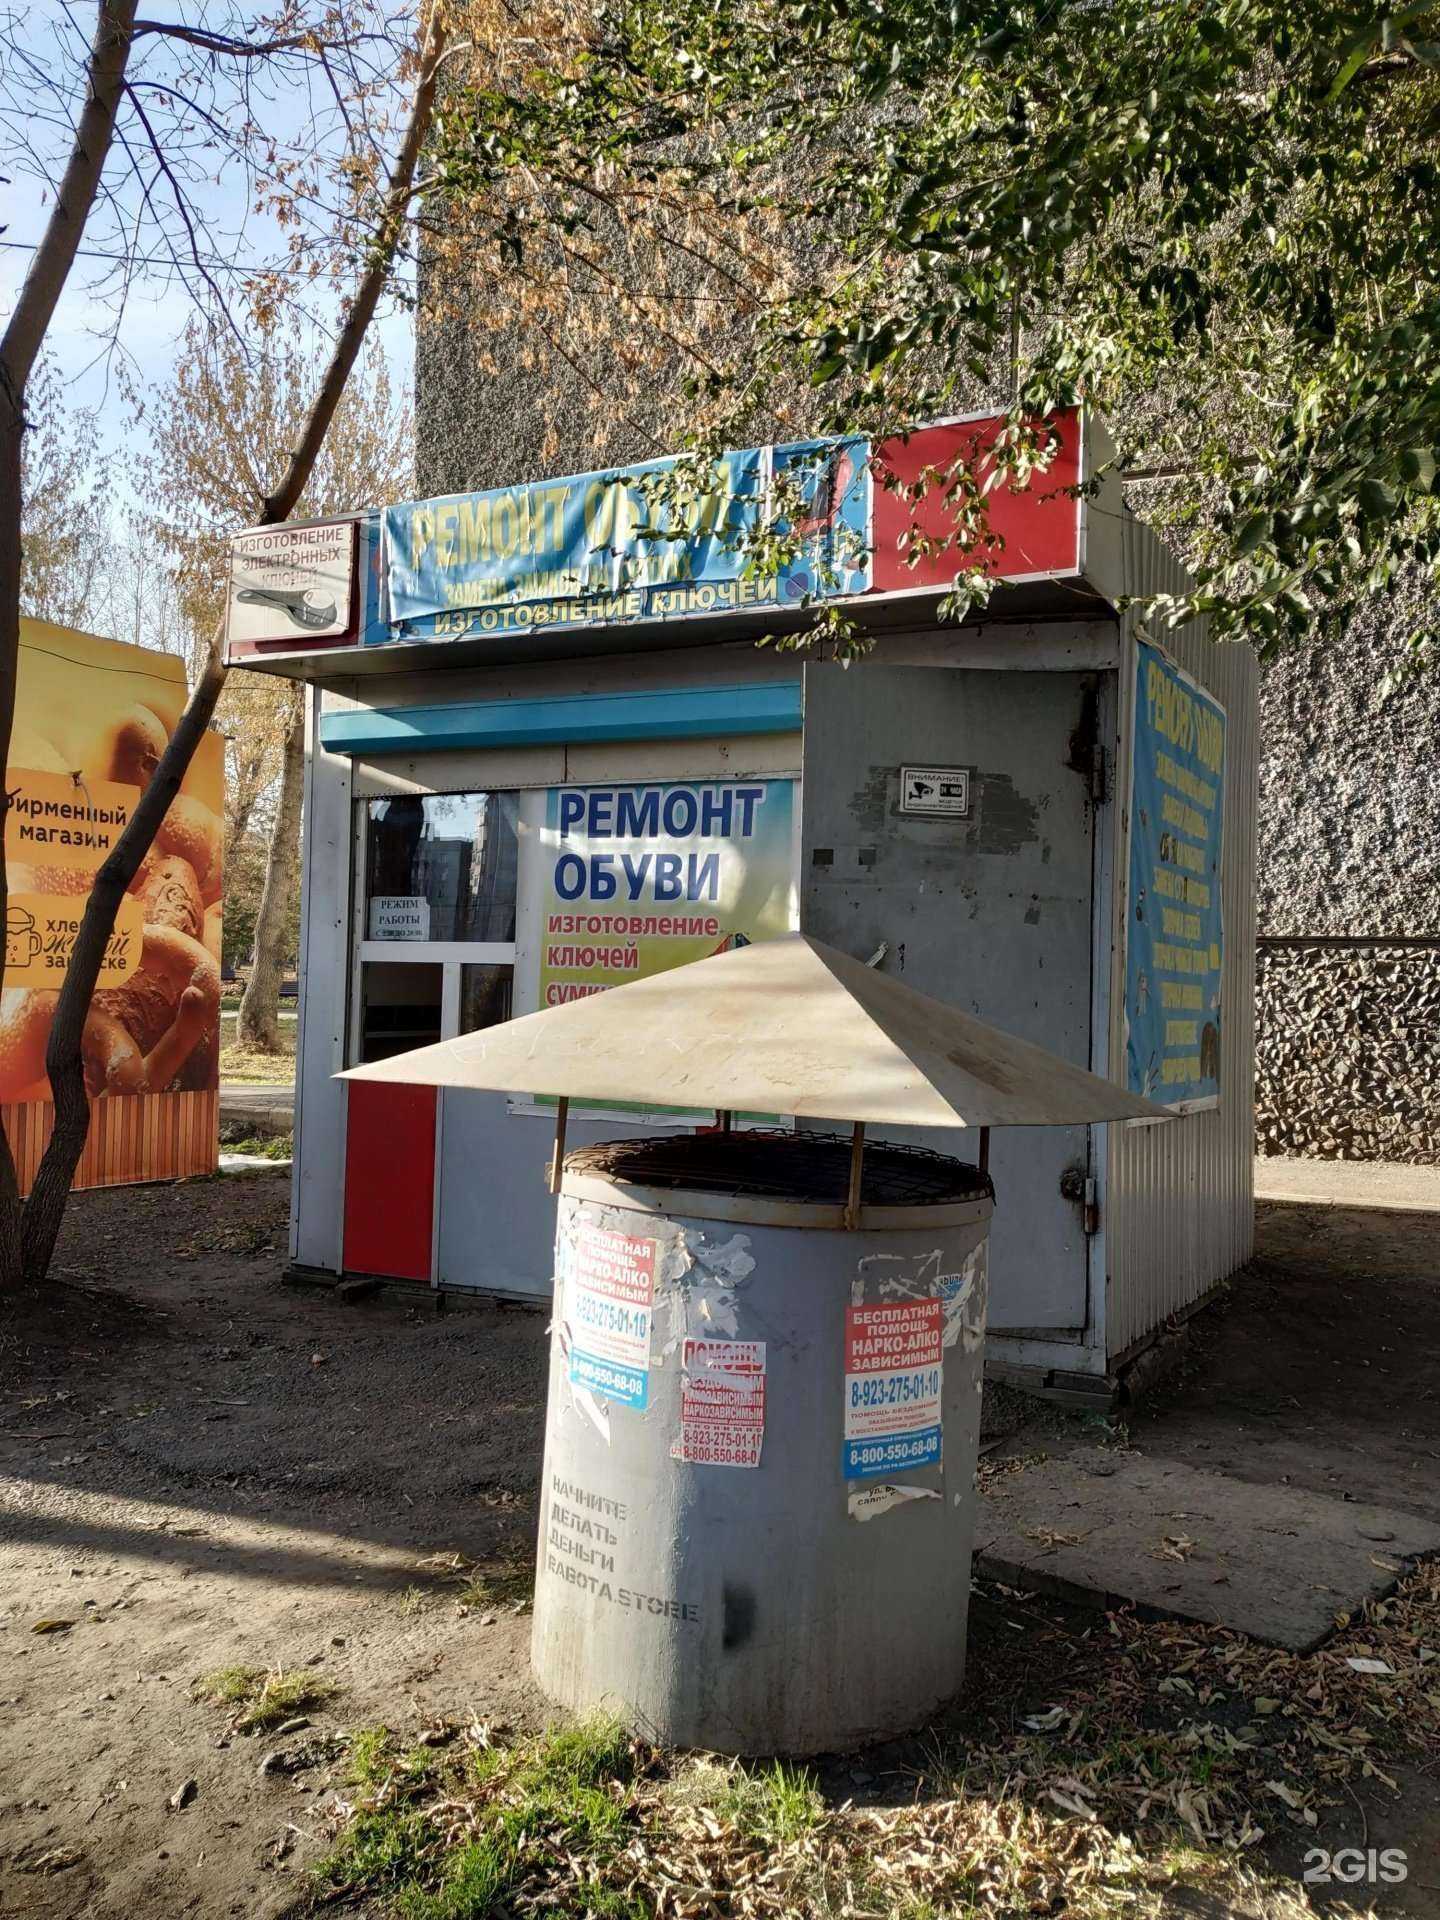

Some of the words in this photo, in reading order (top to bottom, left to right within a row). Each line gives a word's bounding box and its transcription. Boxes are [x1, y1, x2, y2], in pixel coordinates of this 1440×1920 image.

[241, 527, 344, 553] ИЗГОТОВЛЕНИЕ
[411, 487, 570, 571] РЕМОНТ
[242, 547, 341, 571] ЭЛЕКТРОННЫХ
[434, 591, 641, 635] ИЗГОТОВЛЕНИЕ
[559, 788, 764, 839] РЕМОНТ
[20, 824, 109, 849] магазин
[554, 852, 721, 902] ОБУВИ
[381, 899, 419, 909] РЕЖИМ
[45, 919, 79, 933] хле
[379, 914, 420, 925] РАБОТЫ
[549, 915, 719, 936] изготовление
[548, 941, 639, 969] ключей
[853, 1303, 940, 1325] БЕСПЛАТНАЯ
[867, 1319, 930, 1337] ПОМОЩЬ
[852, 1330, 940, 1356] НАРКО-АЛКО
[852, 1348, 939, 1370] ЗАВИСИМЫМ
[850, 1370, 939, 1408] 8-923-275-01-10
[683, 1404, 763, 1421] НАРКОЗАВИСИМЫМ
[850, 1436, 938, 1466] 8-800-550-68-08
[552, 1474, 628, 1521] НАЧНИТЕ
[551, 1503, 618, 1546] ДЕЛАТЬ
[549, 1528, 615, 1573] ДЕНЬГИ
